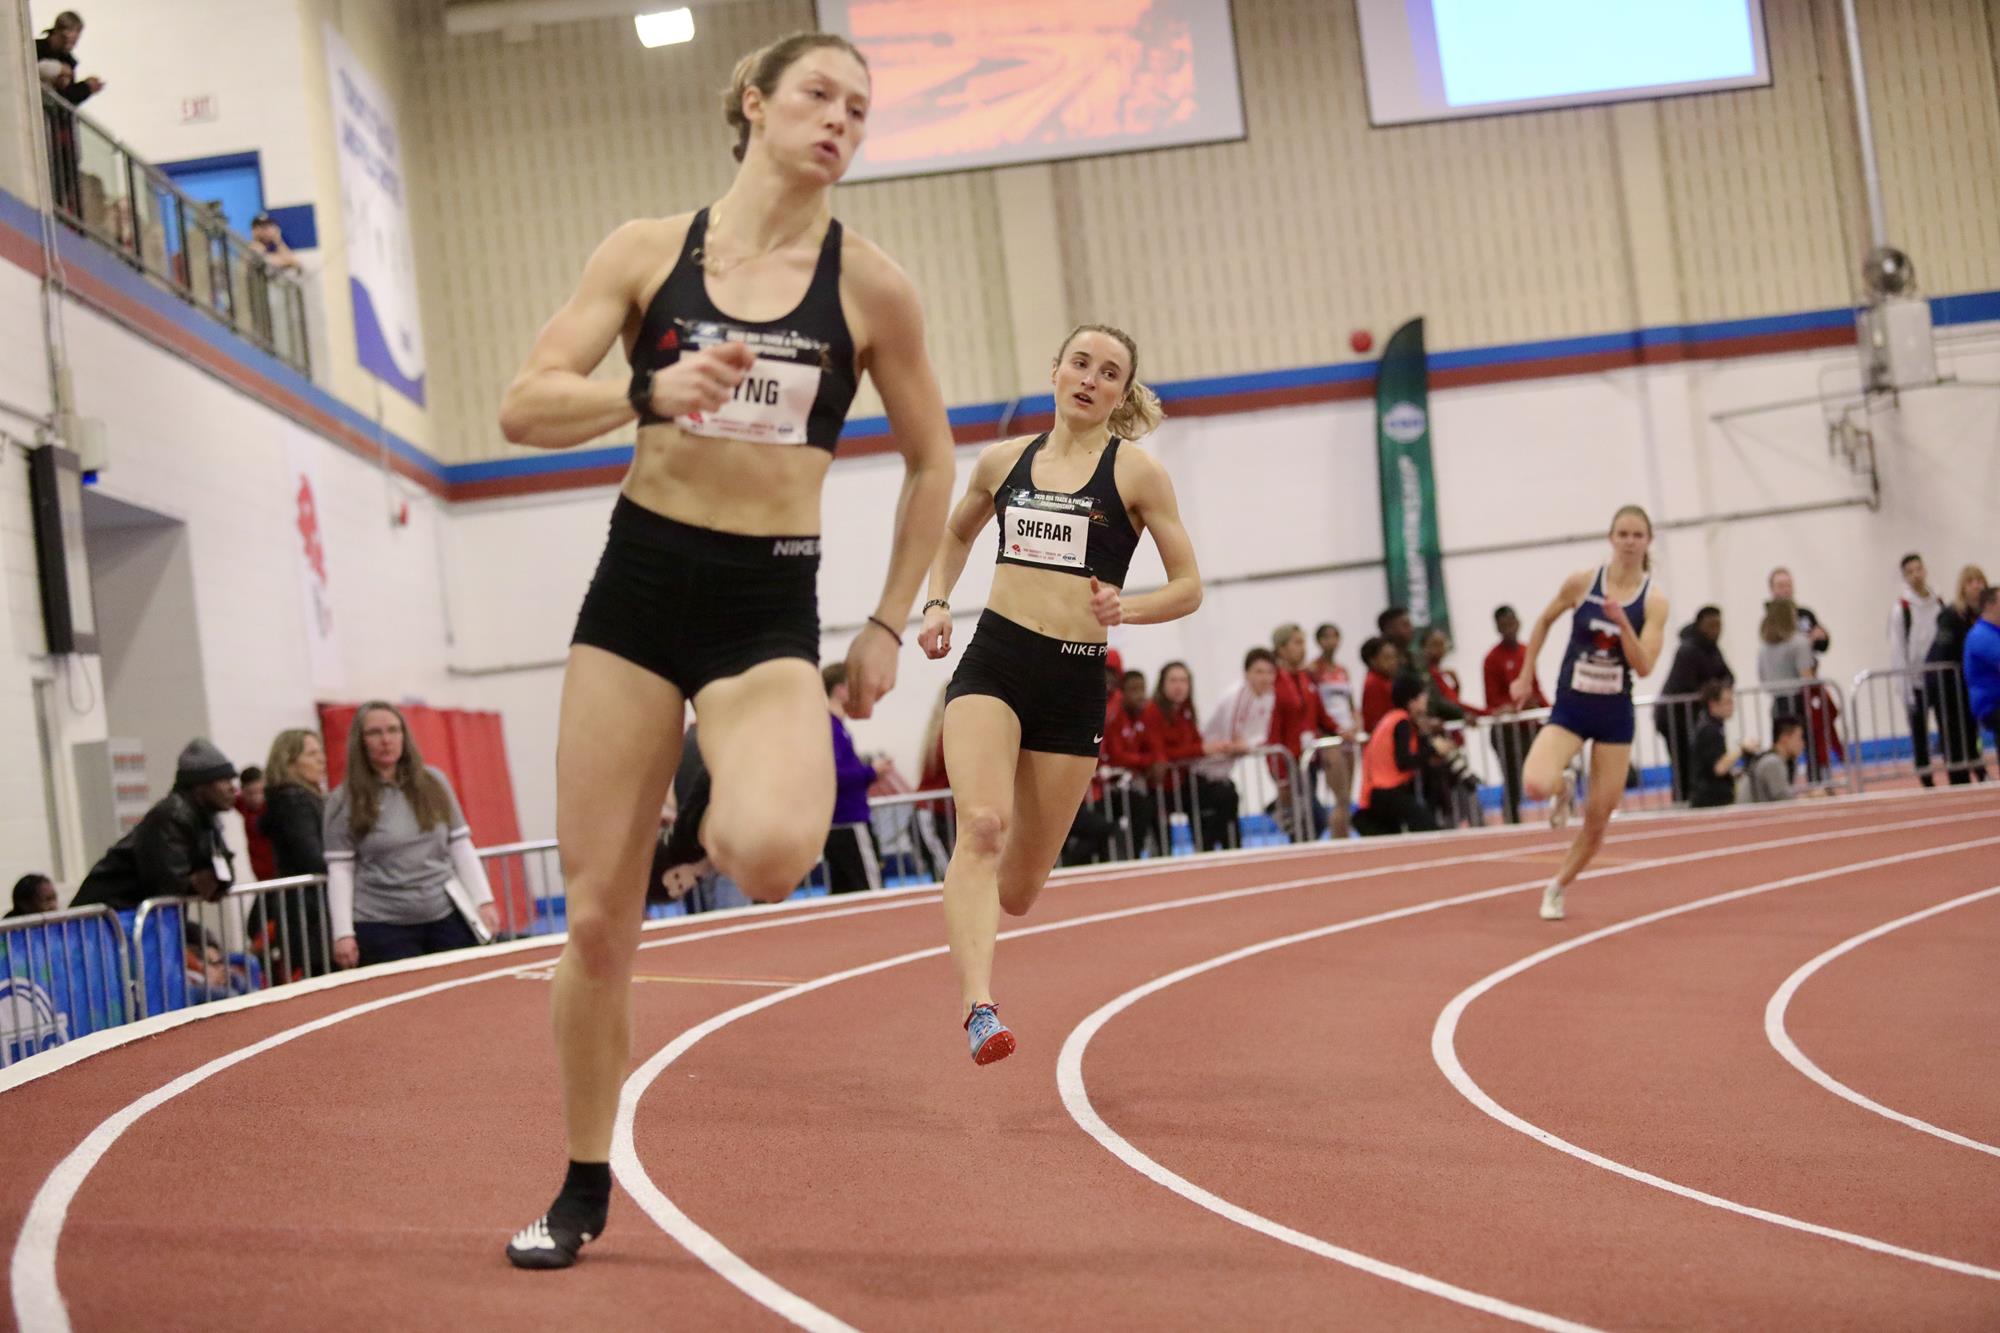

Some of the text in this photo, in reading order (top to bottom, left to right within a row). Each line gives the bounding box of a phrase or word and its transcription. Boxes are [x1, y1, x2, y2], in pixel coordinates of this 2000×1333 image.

[1017, 518, 1072, 543] SHERAR
[773, 540, 816, 557] NIKE
[1061, 642, 1097, 657] NIKE
